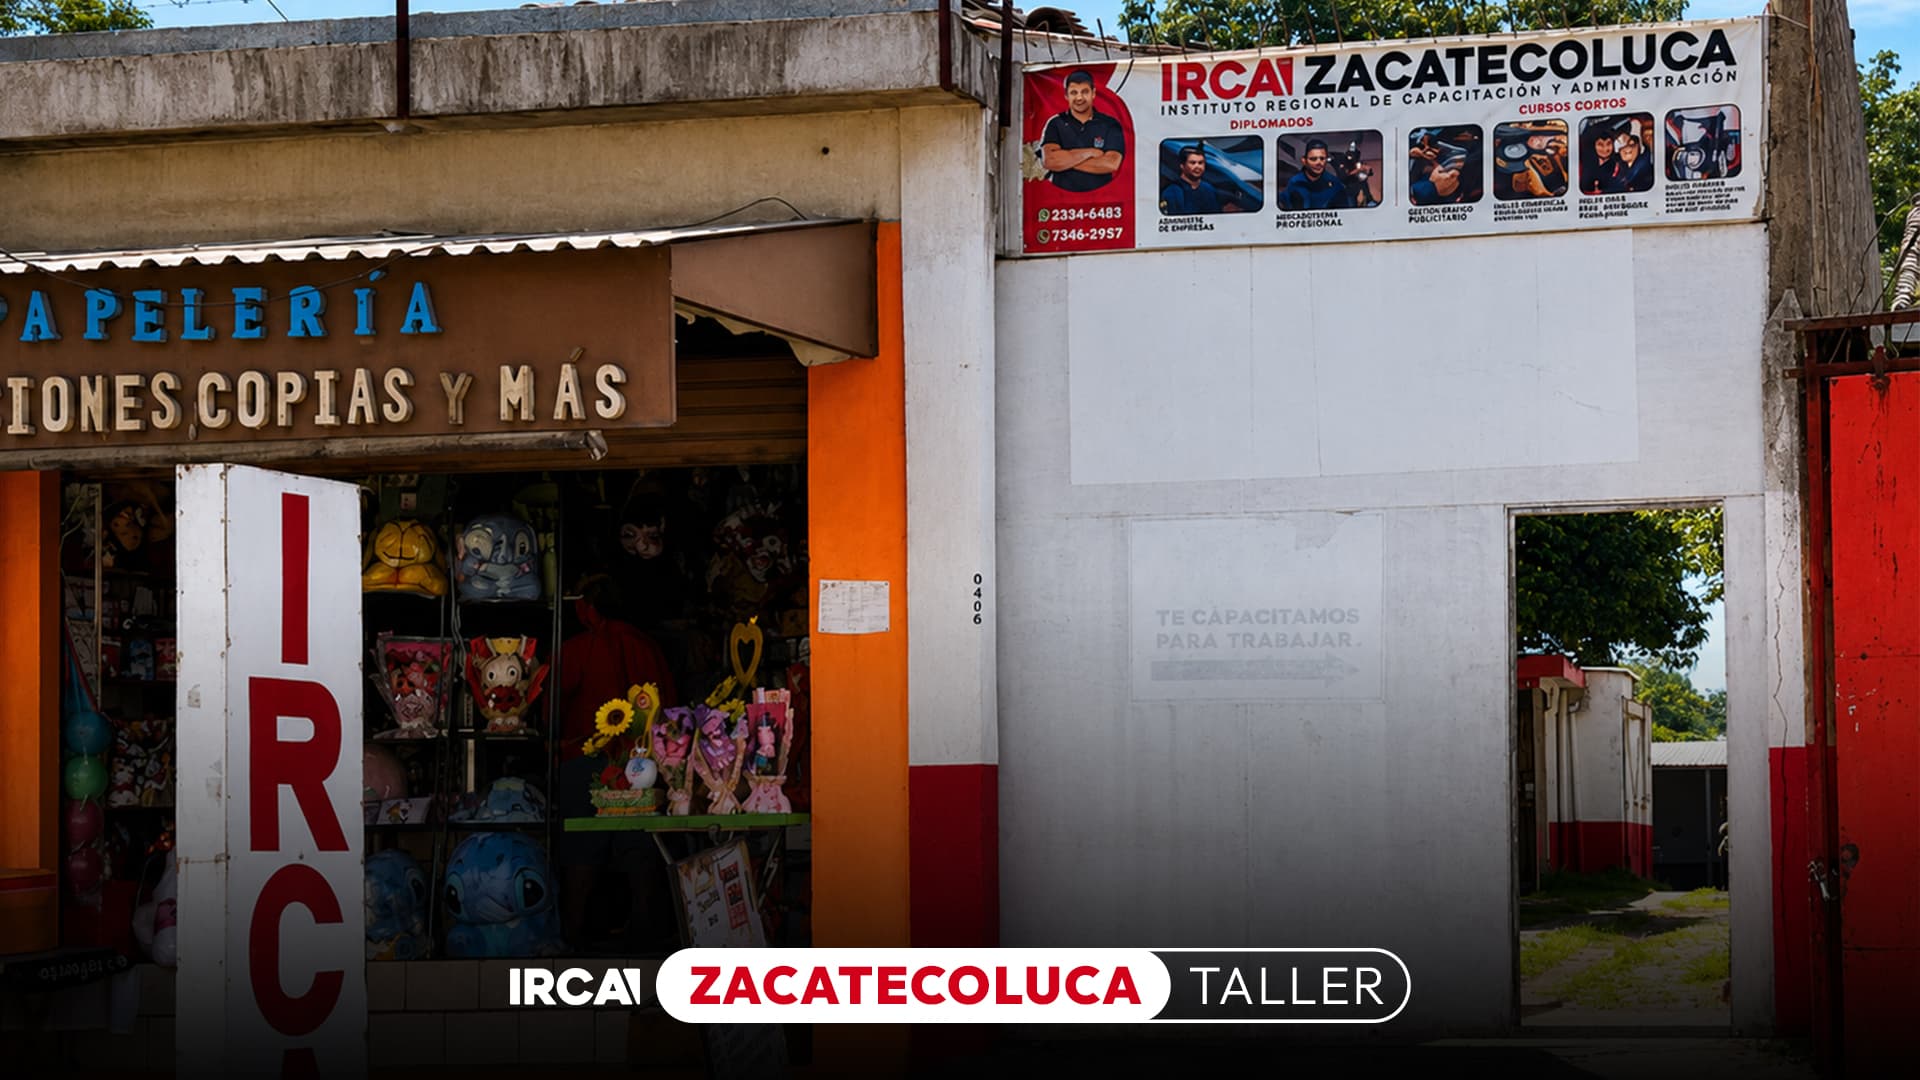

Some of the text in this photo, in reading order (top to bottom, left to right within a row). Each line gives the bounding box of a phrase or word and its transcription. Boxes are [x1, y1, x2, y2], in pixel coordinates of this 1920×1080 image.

[1304, 29, 1737, 95] ZACATECOLUCA
[1161, 68, 1738, 116] INSTITUTO REGIONAL DE CAPACITACIÓN Y ADMINISTRACIÓN
[1519, 98, 1627, 115] CURSOS CORTOS
[1230, 117, 1314, 130] DIPLOMADOS
[1051, 206, 1122, 221] 2334-6483
[0, 270, 442, 342] APELERÍA
[0, 347, 627, 435] IONES COPIAS Y MÁS
[973, 573, 982, 625] 0406
[1156, 607, 1360, 627] TE CAPACITAMOS
[1156, 631, 1362, 649] PARA TRABAJAR.
[248, 493, 350, 1080] IRC
